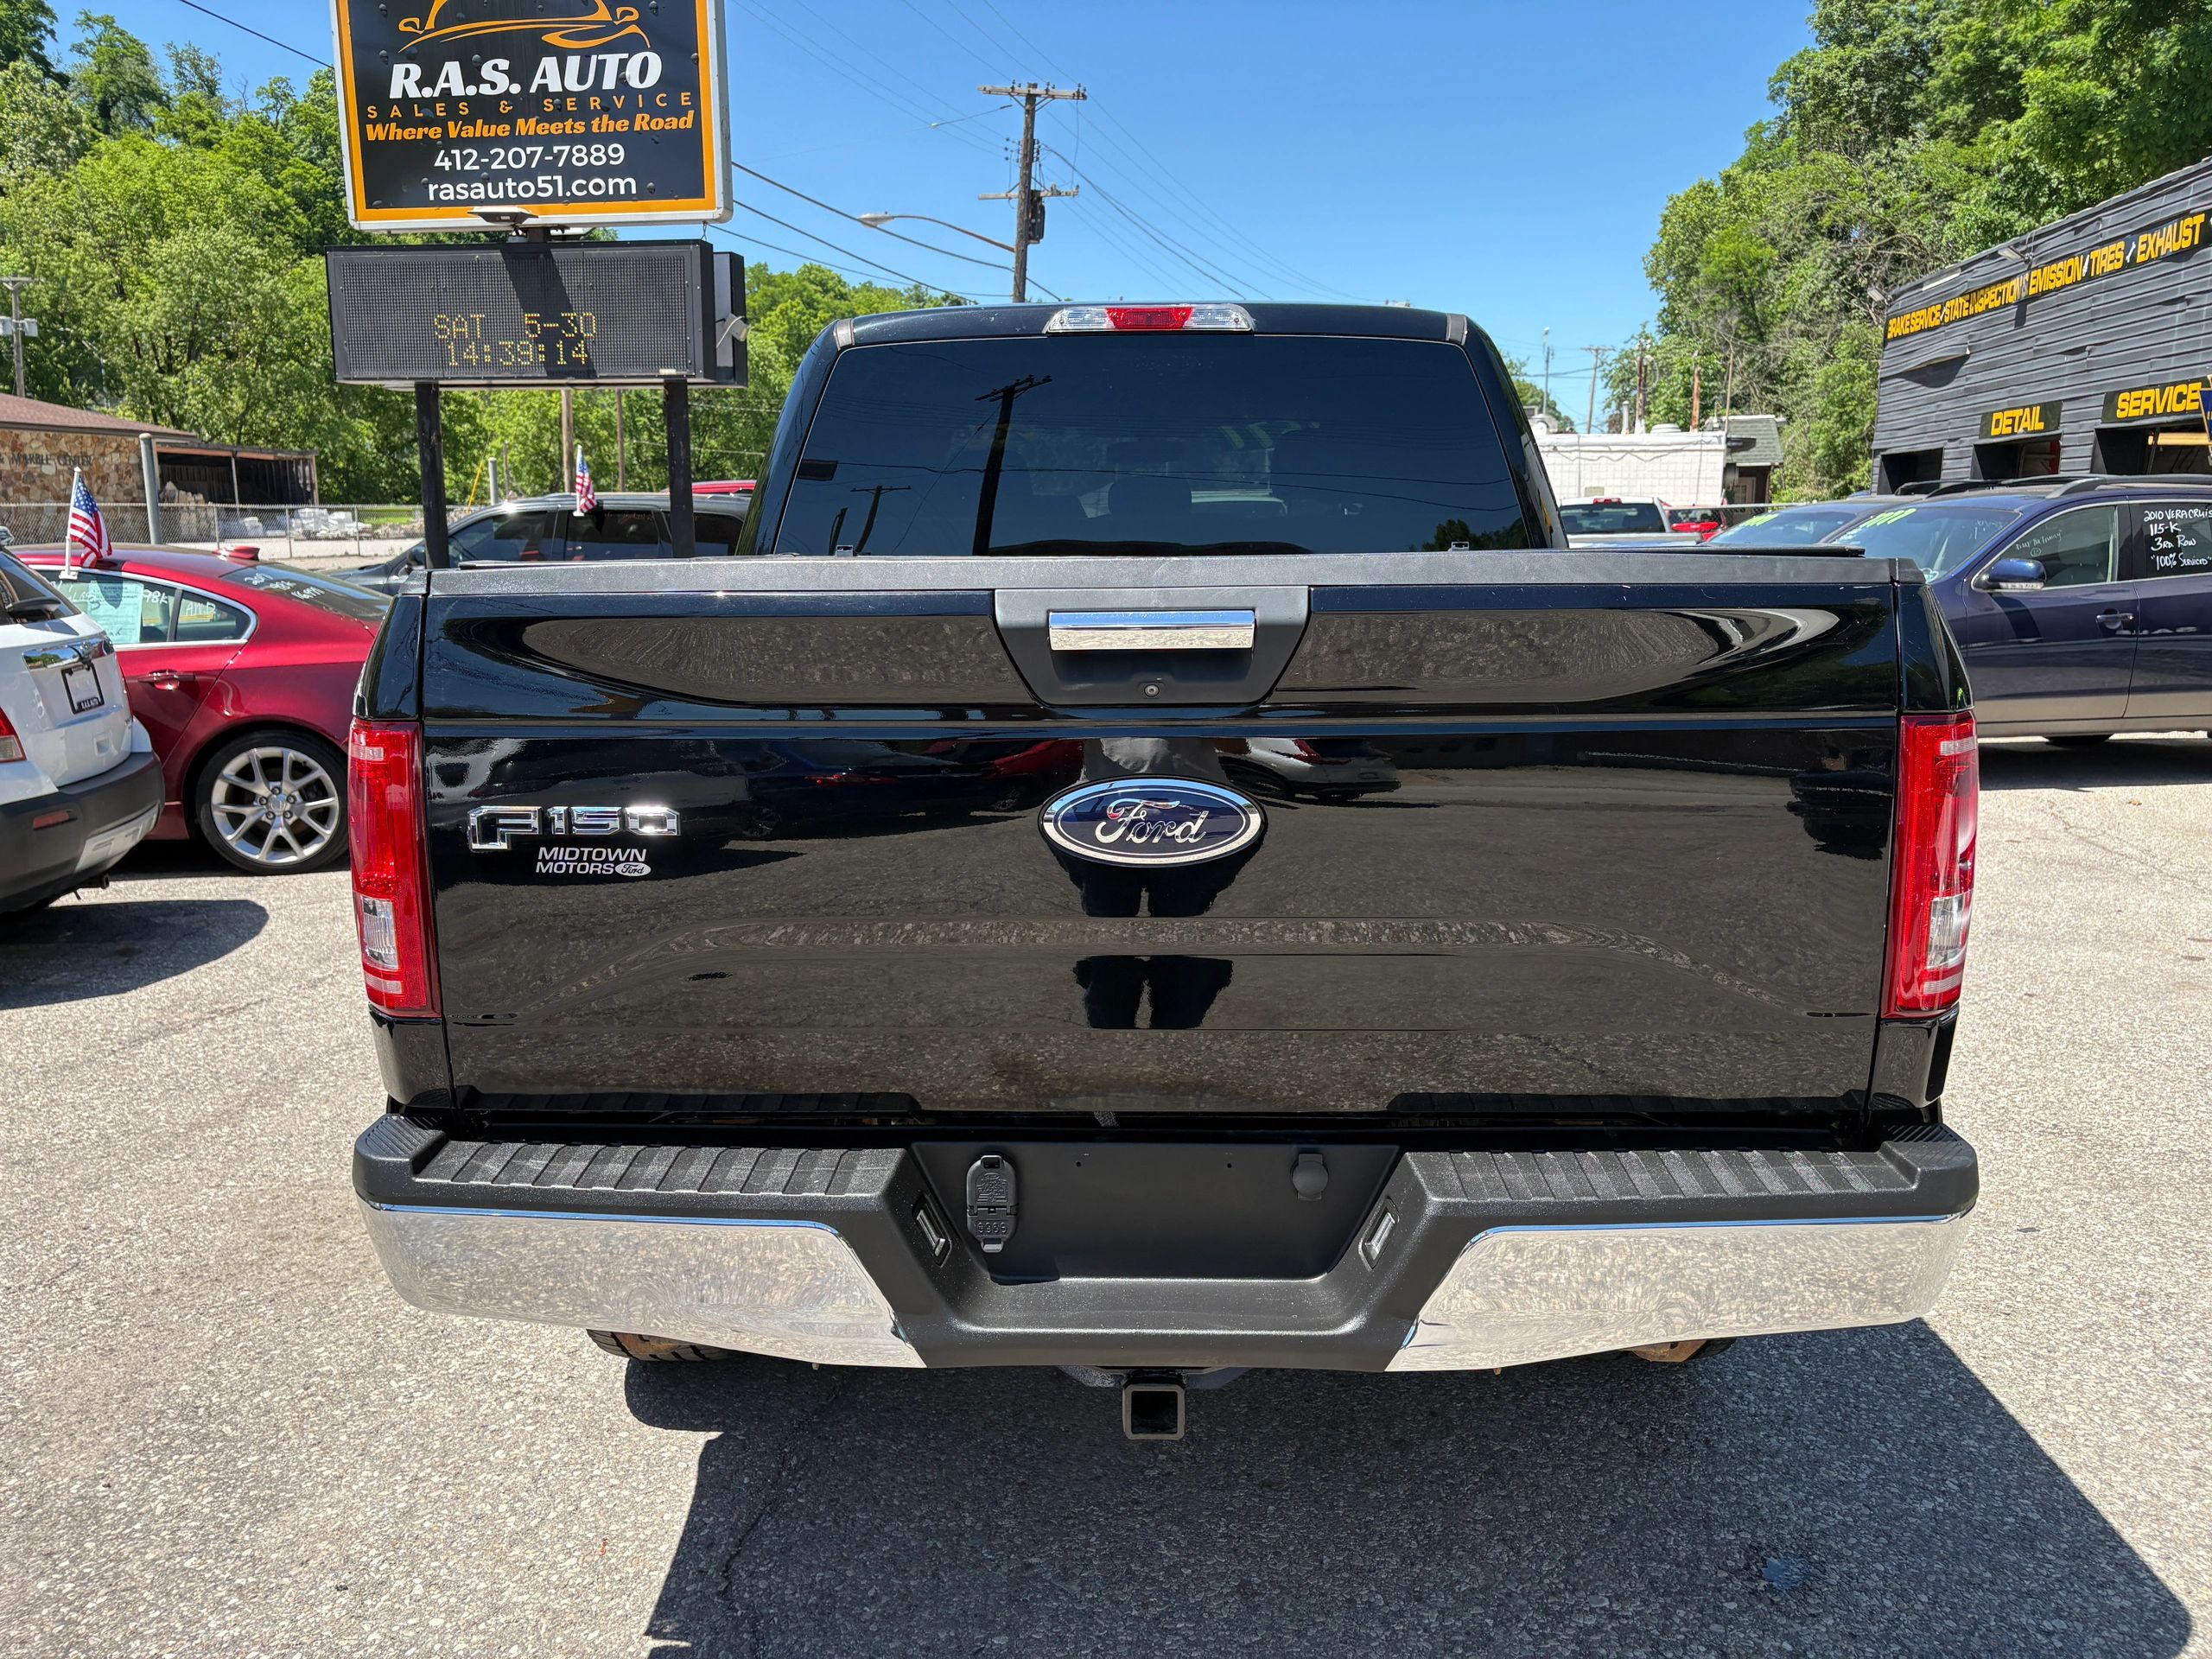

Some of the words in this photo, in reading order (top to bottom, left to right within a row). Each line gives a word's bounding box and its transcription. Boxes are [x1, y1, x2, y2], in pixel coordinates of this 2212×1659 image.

[389, 58, 521, 99] R.A.S.
[529, 51, 662, 93] AUTO
[366, 102, 470, 119] SALES
[499, 100, 513, 114] &
[543, 92, 692, 112] SERVICE
[365, 123, 442, 141] Where
[448, 119, 511, 139] Value
[515, 117, 586, 136] Meets
[591, 113, 630, 133] the
[633, 110, 695, 131] Road
[434, 143, 625, 171] 412-207-7889
[428, 175, 637, 200] rasauto51.com
[1910, 304, 1942, 331] SERVICE
[1943, 297, 1969, 323] STATE
[1969, 275, 2021, 315] INSPECTION
[2029, 254, 2084, 296] EMISSION
[2089, 240, 2126, 277] TIRES
[2136, 213, 2205, 264] EXHAUST
[434, 313, 486, 340] SAT
[524, 312, 598, 339] 5-30
[447, 340, 588, 366] 14:39:14
[2115, 381, 2202, 420] SERVICE
[1990, 405, 2045, 437] DETAIL
[2144, 510, 2164, 522] 2010
[1096, 798, 1210, 844] Ford
[536, 861, 614, 874] MOTORS
[621, 862, 645, 875] Ford
[537, 847, 646, 861] MIDTOWN
